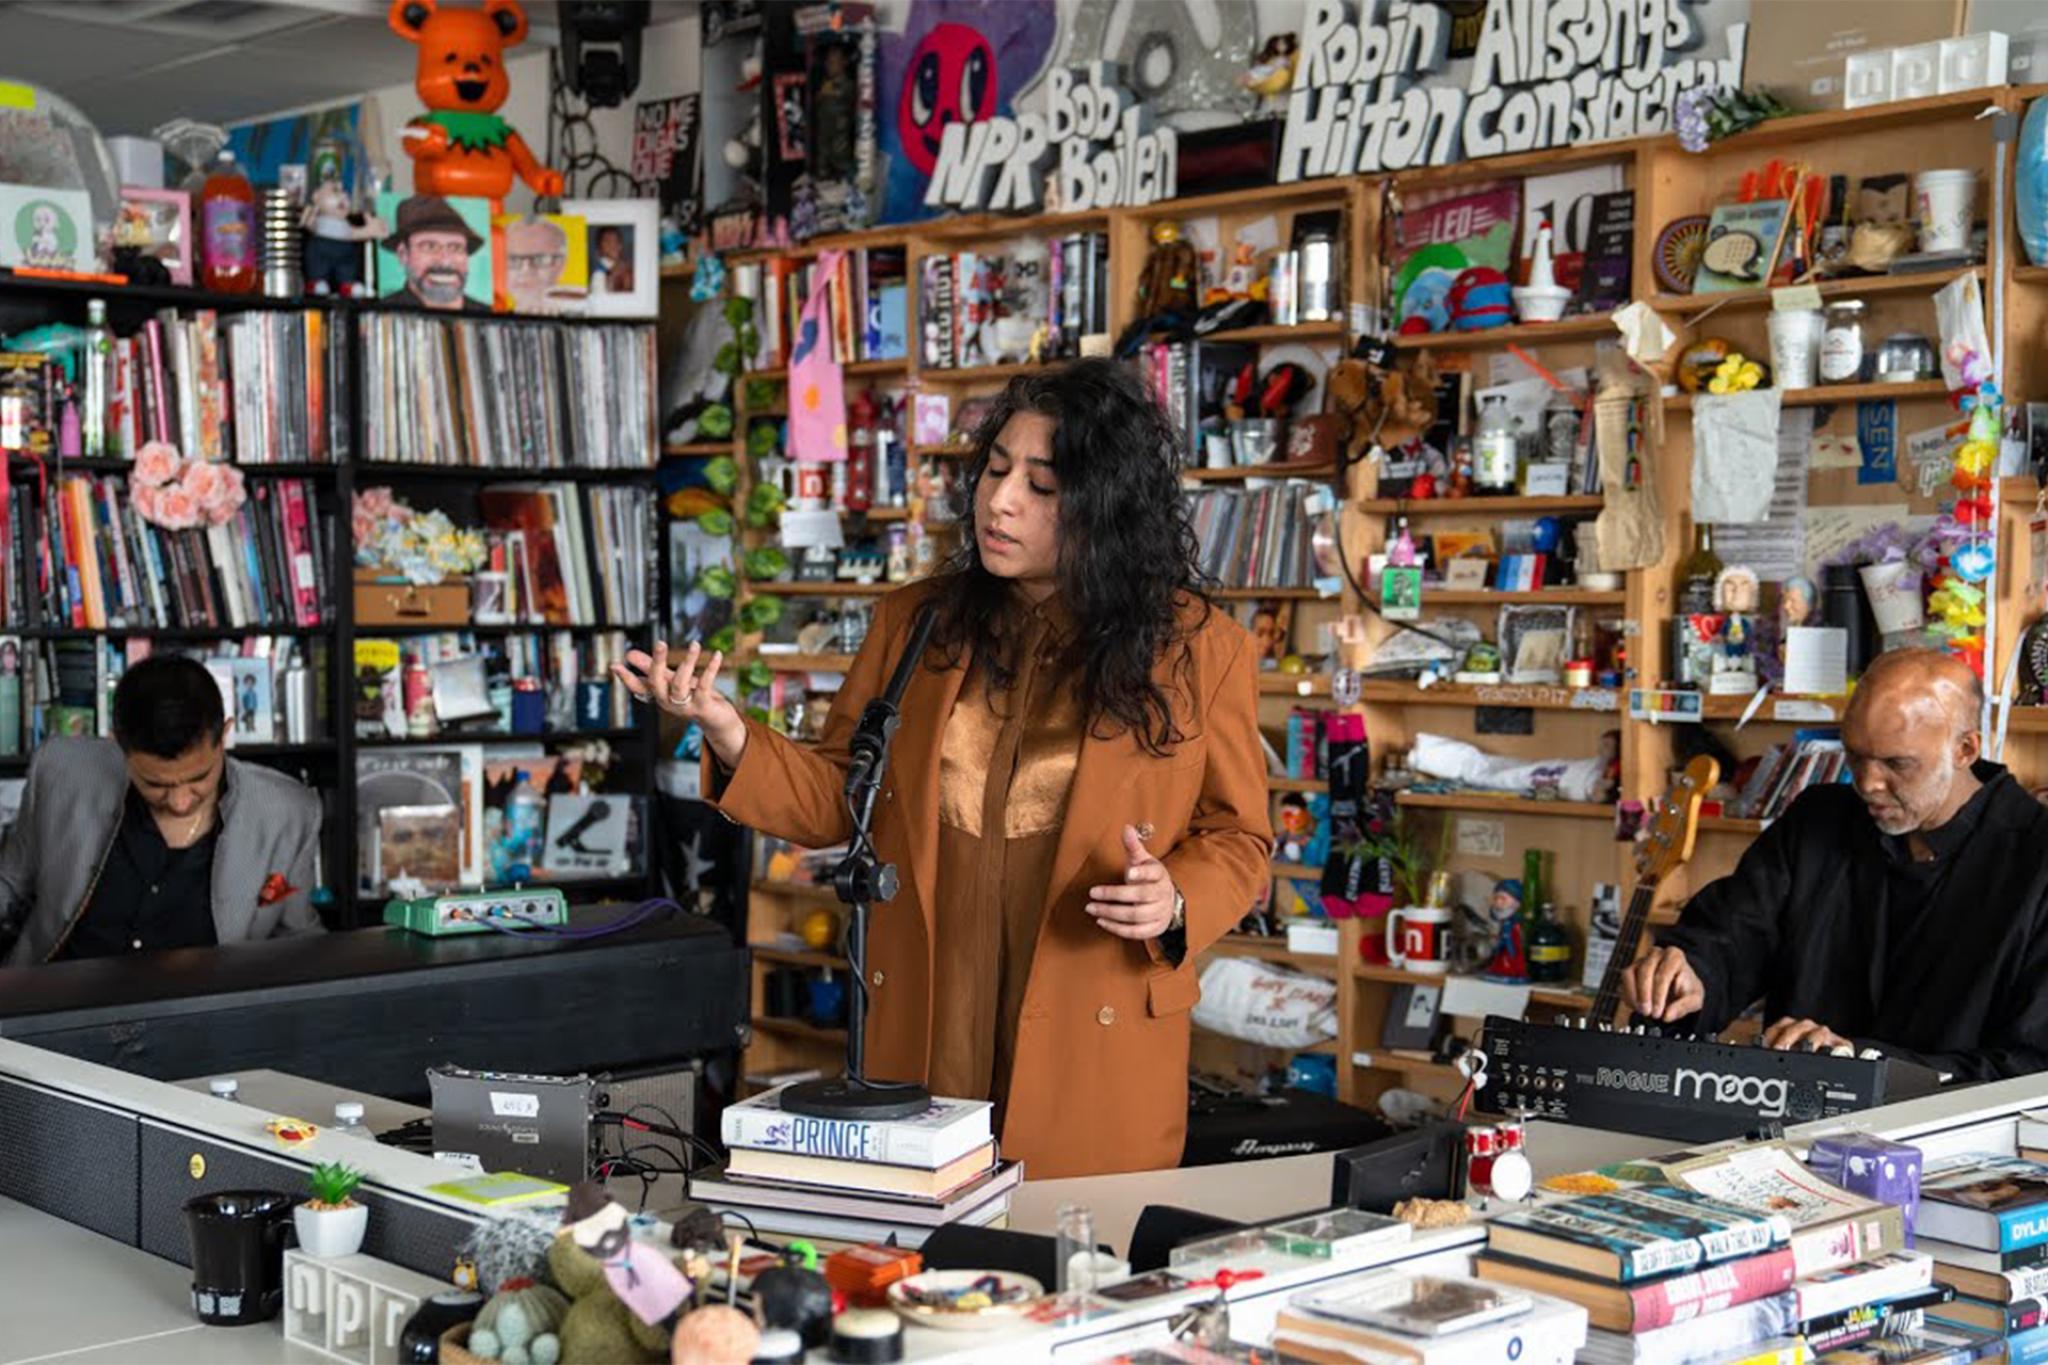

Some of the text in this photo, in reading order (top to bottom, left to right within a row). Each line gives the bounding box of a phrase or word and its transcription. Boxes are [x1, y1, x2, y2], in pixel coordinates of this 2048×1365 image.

[1294, 0, 1441, 91] Robin
[1860, 47, 1978, 96] npr
[637, 103, 667, 129] NO
[1047, 66, 1119, 144] Bob
[1277, 70, 1465, 184] Hilton
[924, 114, 1047, 209] NPR
[1061, 118, 1178, 211] Boilen
[1596, 1066, 1670, 1094] ROGUE
[1673, 1067, 1788, 1118] moog
[791, 1117, 871, 1160] PRINCE
[292, 1264, 405, 1347] npr
